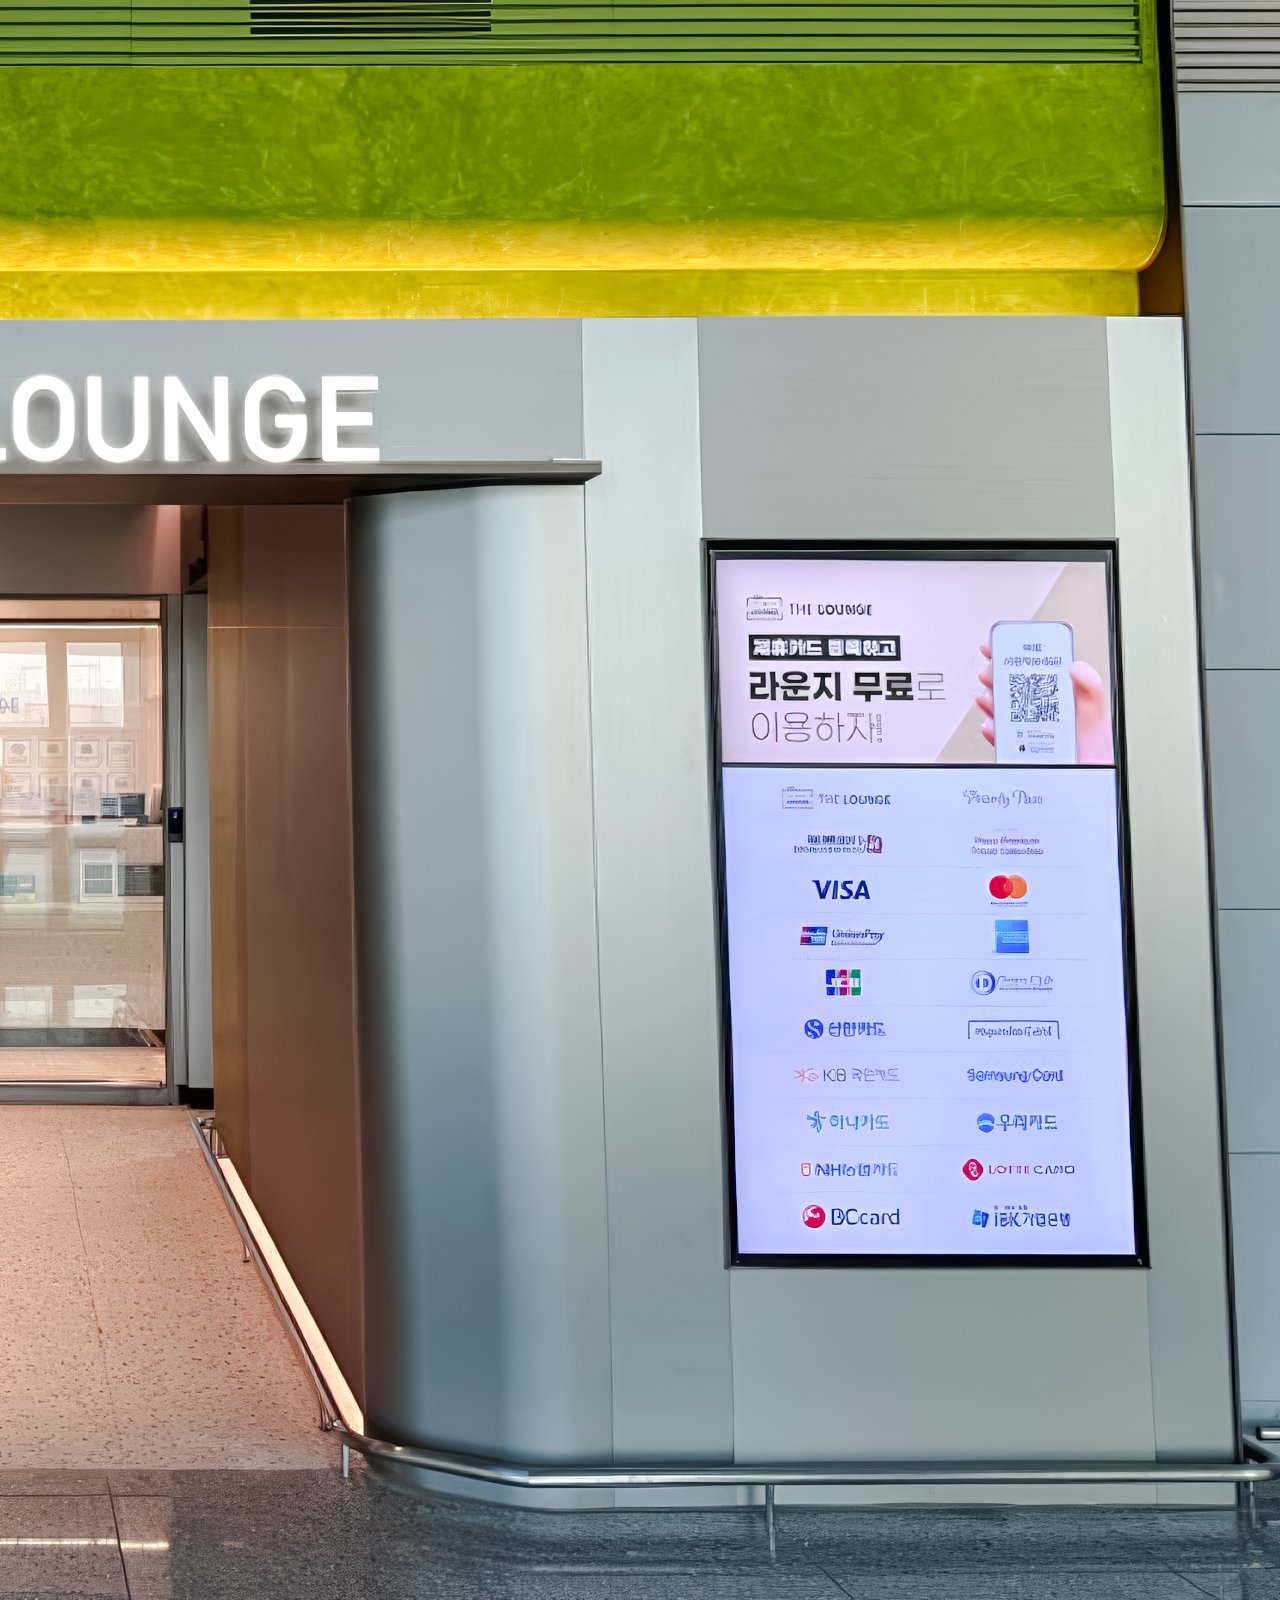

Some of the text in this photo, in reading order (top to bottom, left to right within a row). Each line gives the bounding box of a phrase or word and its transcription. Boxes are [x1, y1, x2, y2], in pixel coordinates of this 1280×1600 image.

[749, 671, 946, 702] 라운지 무료로
[812, 879, 871, 900] VISA
